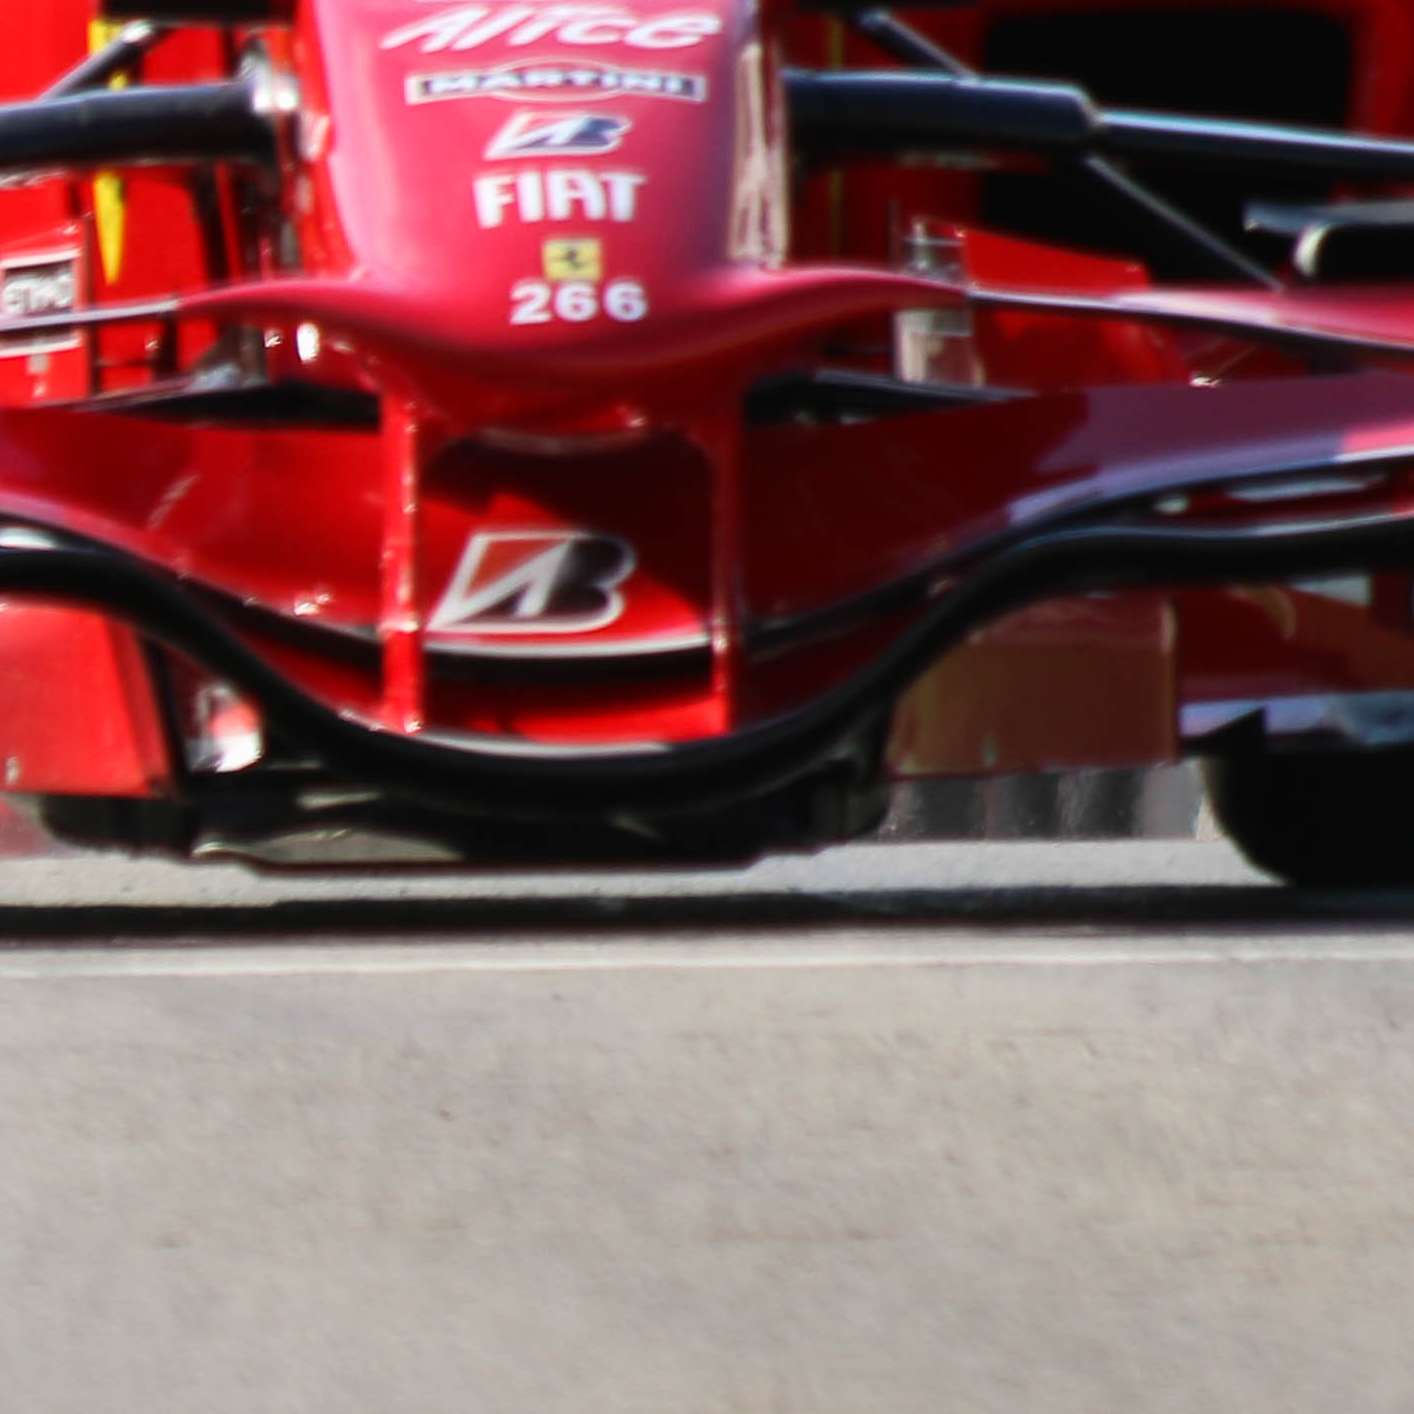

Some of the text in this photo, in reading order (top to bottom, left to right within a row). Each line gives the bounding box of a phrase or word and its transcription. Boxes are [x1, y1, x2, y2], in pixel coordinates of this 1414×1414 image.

[427, 68, 684, 93] MARTINI
[474, 169, 647, 229] FIAT
[509, 278, 649, 326] 266
